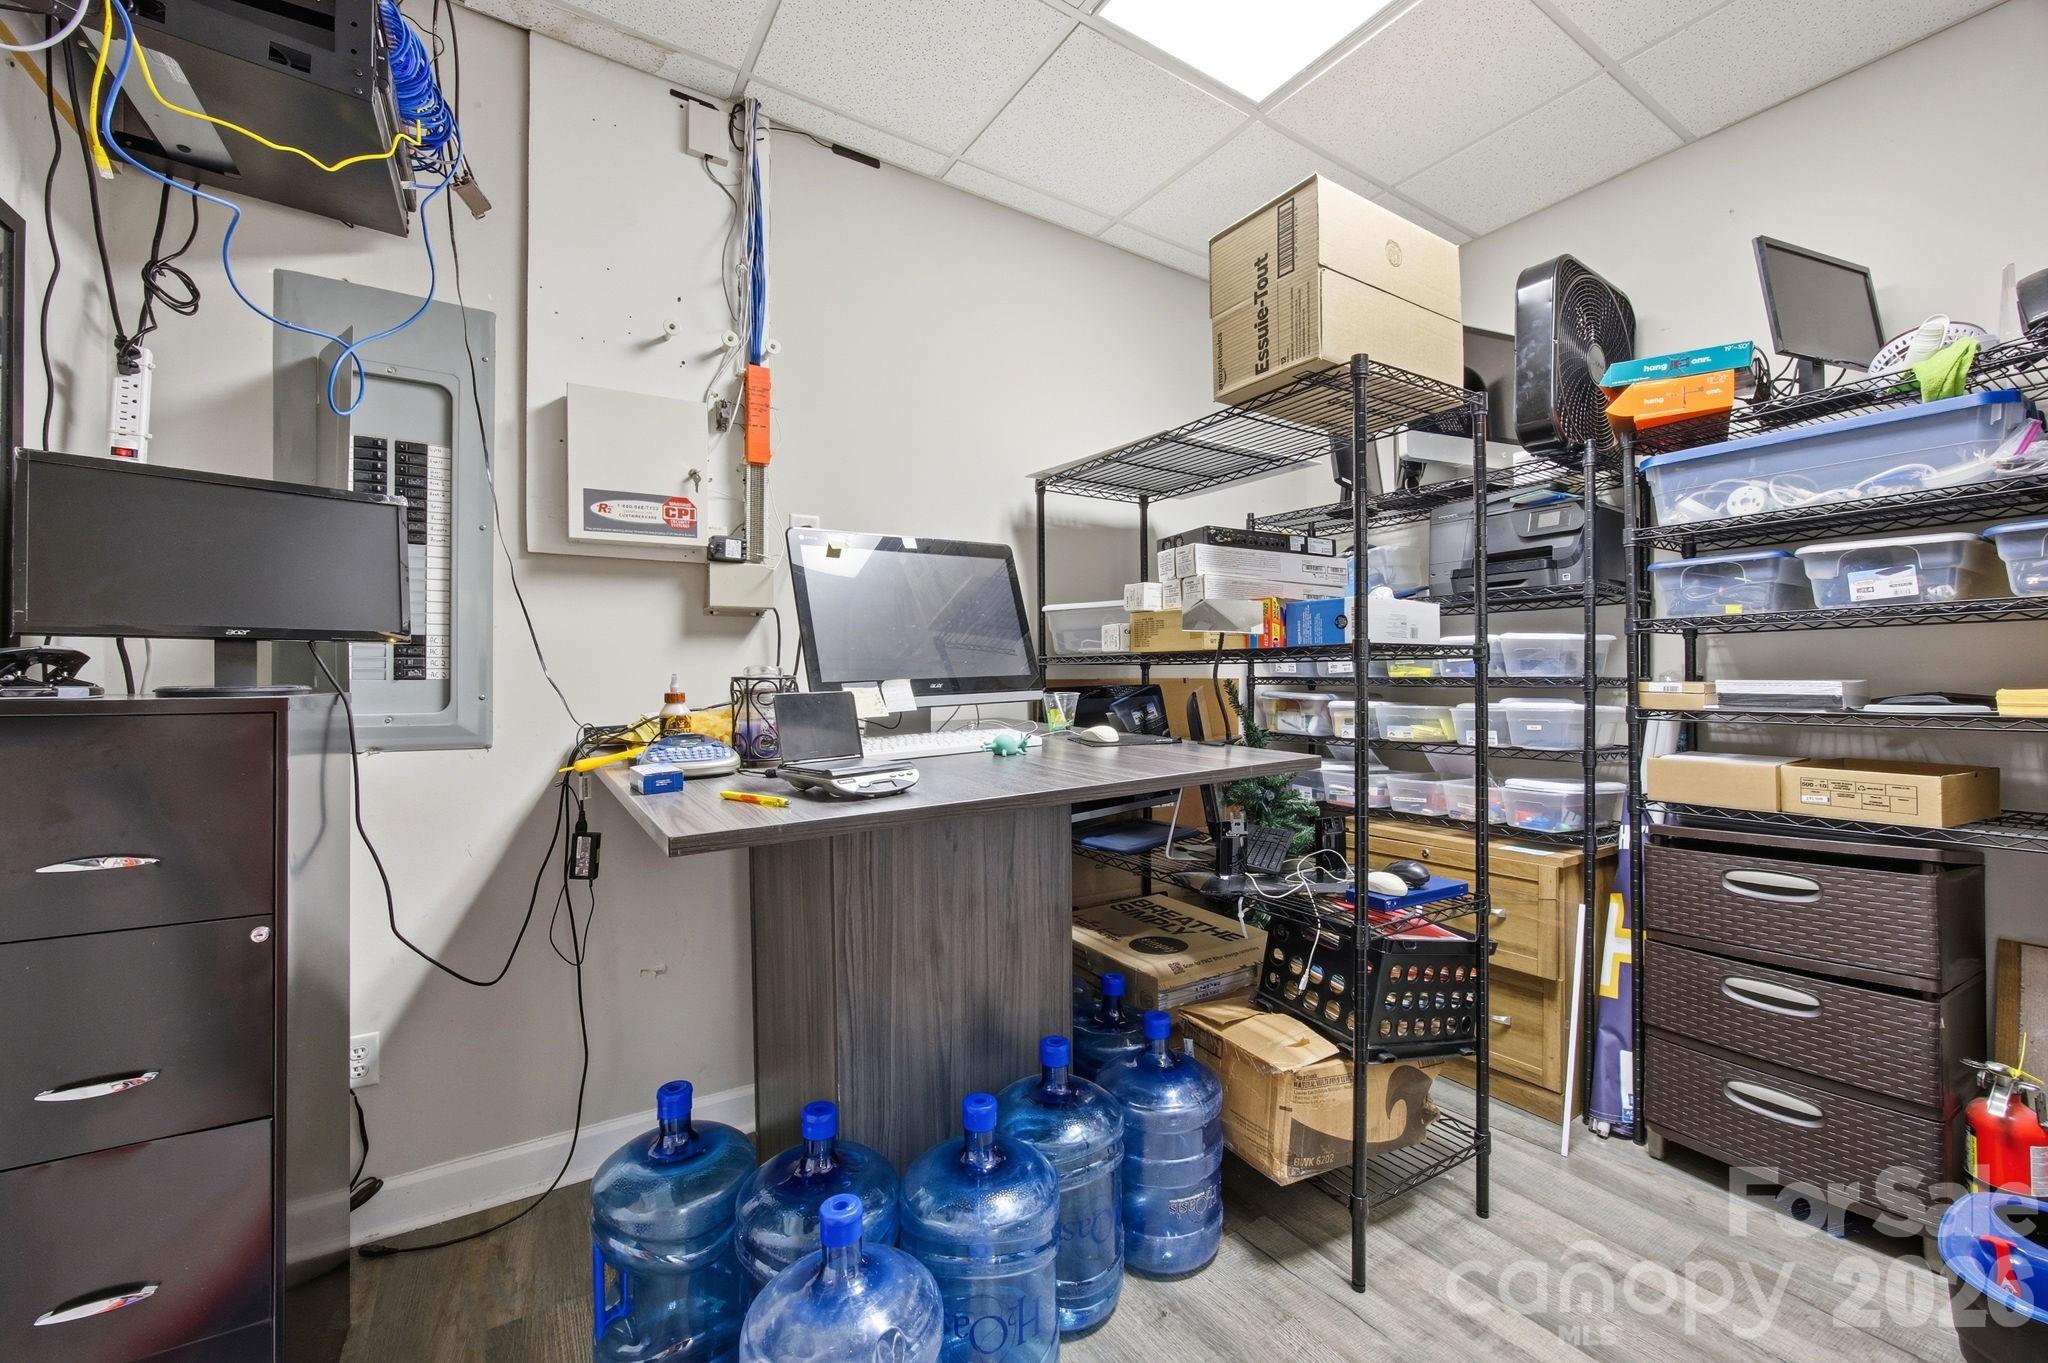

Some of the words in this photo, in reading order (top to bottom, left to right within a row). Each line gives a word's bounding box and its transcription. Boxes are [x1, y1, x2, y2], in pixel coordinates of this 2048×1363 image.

[1254, 252, 1269, 376] Essuie-Tout
[1643, 363, 1668, 373] hang
[664, 506, 695, 520] CPI
[1110, 903, 1197, 935] SIMPLY
[1130, 898, 1247, 942] BREATHE
[1293, 1156, 1315, 1167] BWK
[1316, 1153, 1335, 1165] 6202
